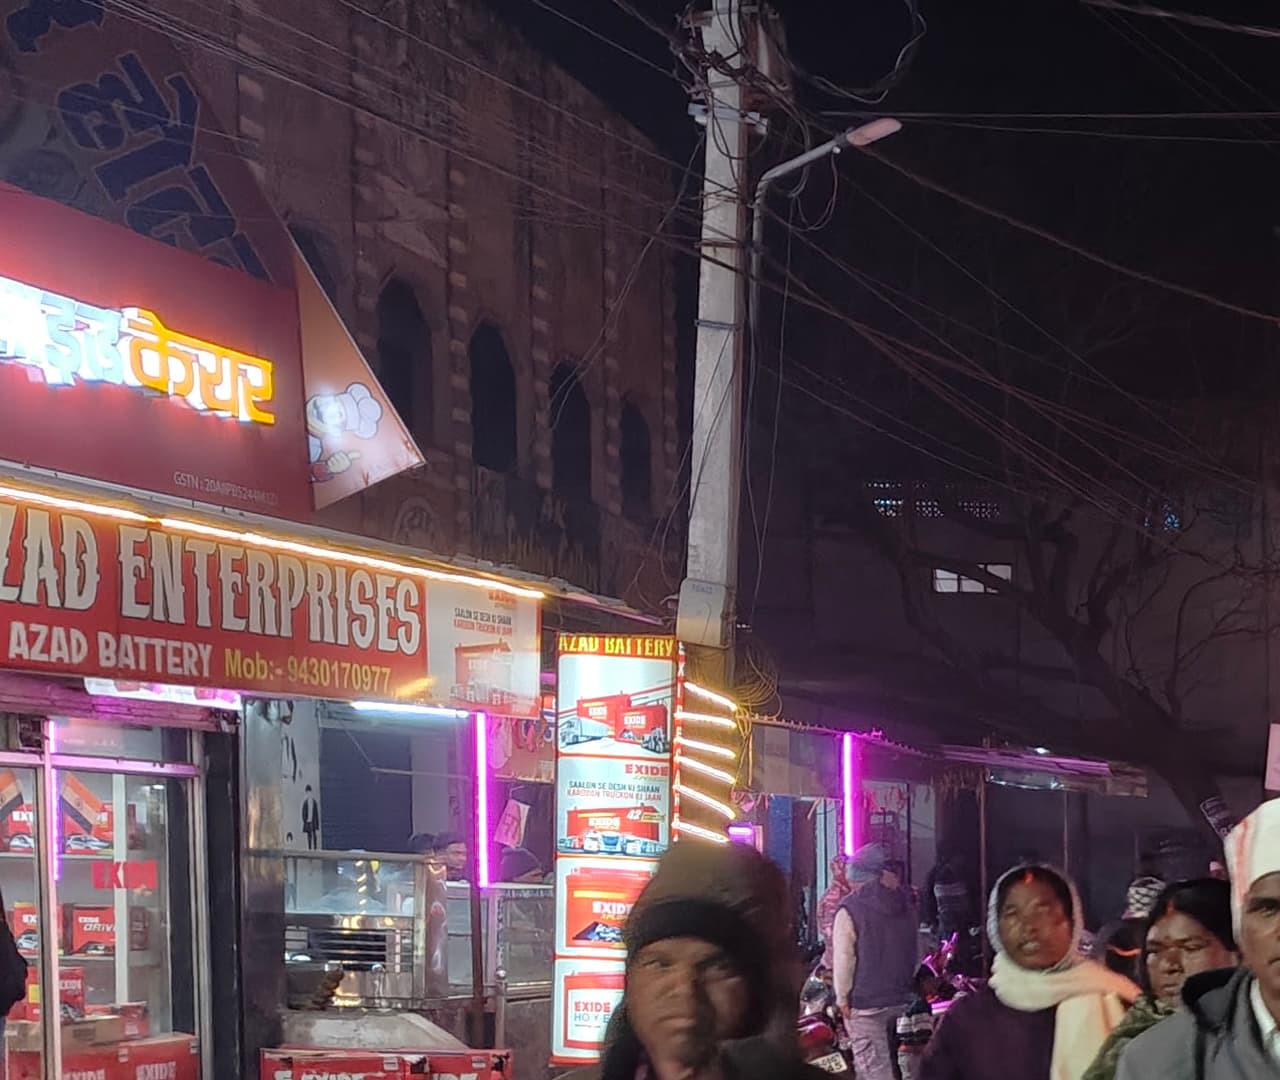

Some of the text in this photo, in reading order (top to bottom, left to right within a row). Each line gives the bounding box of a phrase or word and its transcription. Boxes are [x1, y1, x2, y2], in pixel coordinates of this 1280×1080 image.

[123, 306, 275, 425] केयर
[118, 523, 421, 656] ENTERPRISES
[558, 635, 675, 657] AZAD BATTERY
[8, 620, 88, 664] AZAD
[97, 631, 213, 678] BATTERY
[287, 655, 391, 695] 9430170977
[624, 763, 669, 777] EXIDE
[574, 1001, 611, 1012] EXIDE
[136, 1061, 177, 1080] EXIDE
